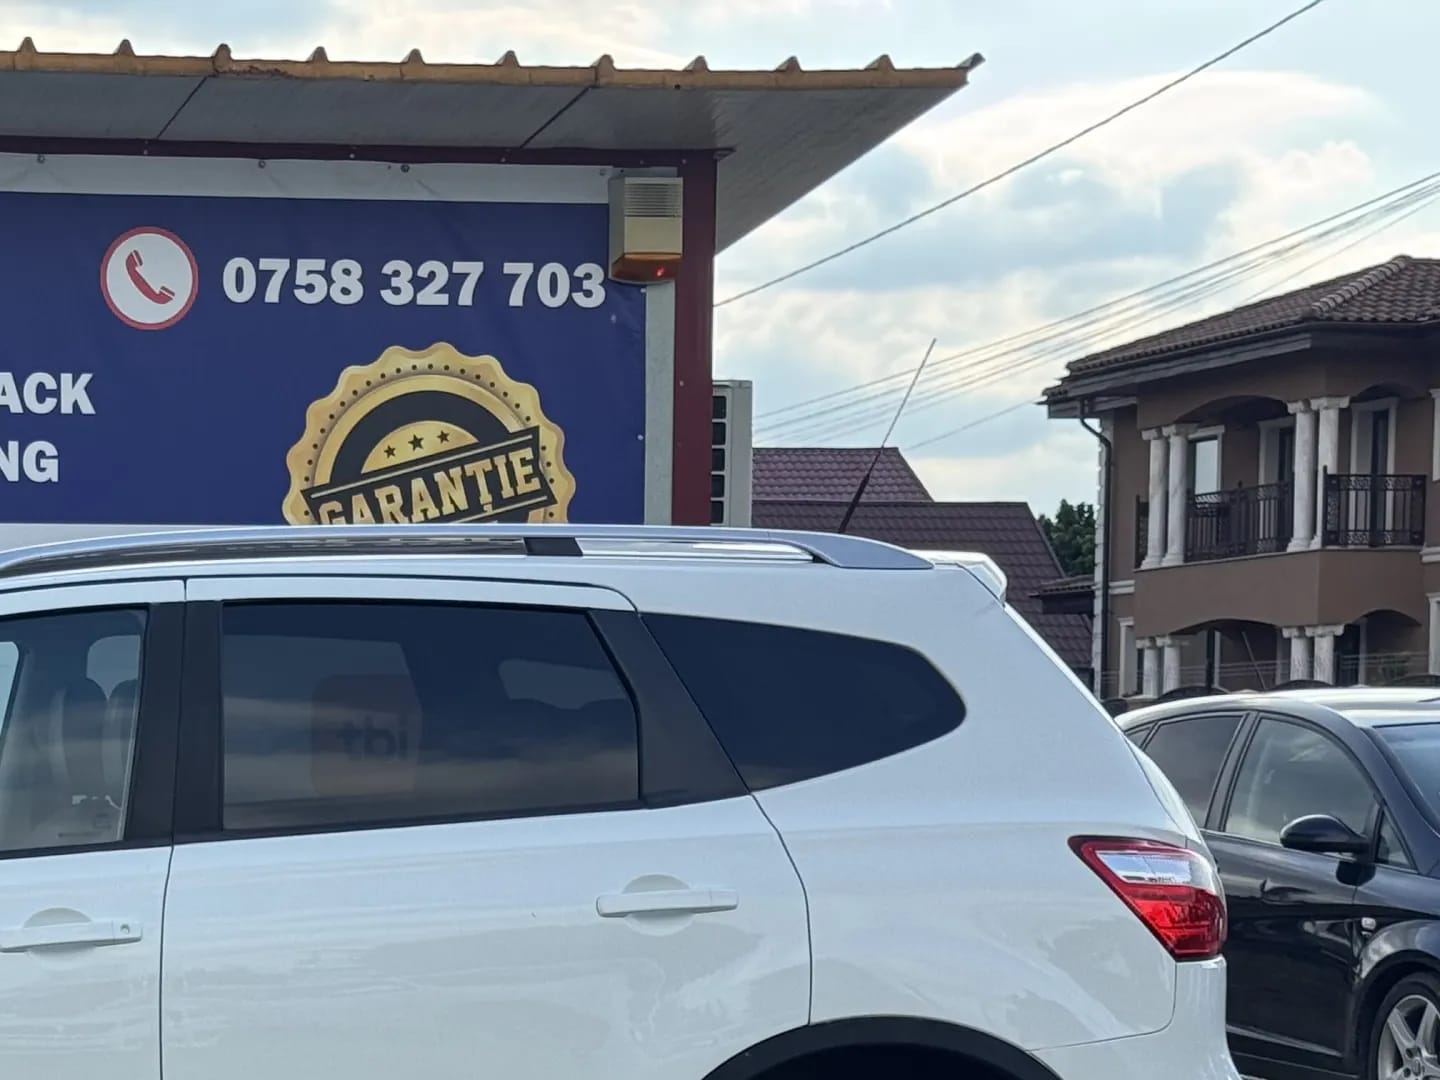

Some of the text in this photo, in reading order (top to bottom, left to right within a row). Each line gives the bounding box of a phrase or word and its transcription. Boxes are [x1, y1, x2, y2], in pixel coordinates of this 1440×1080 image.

[222, 257, 607, 309] 0758 327 703
